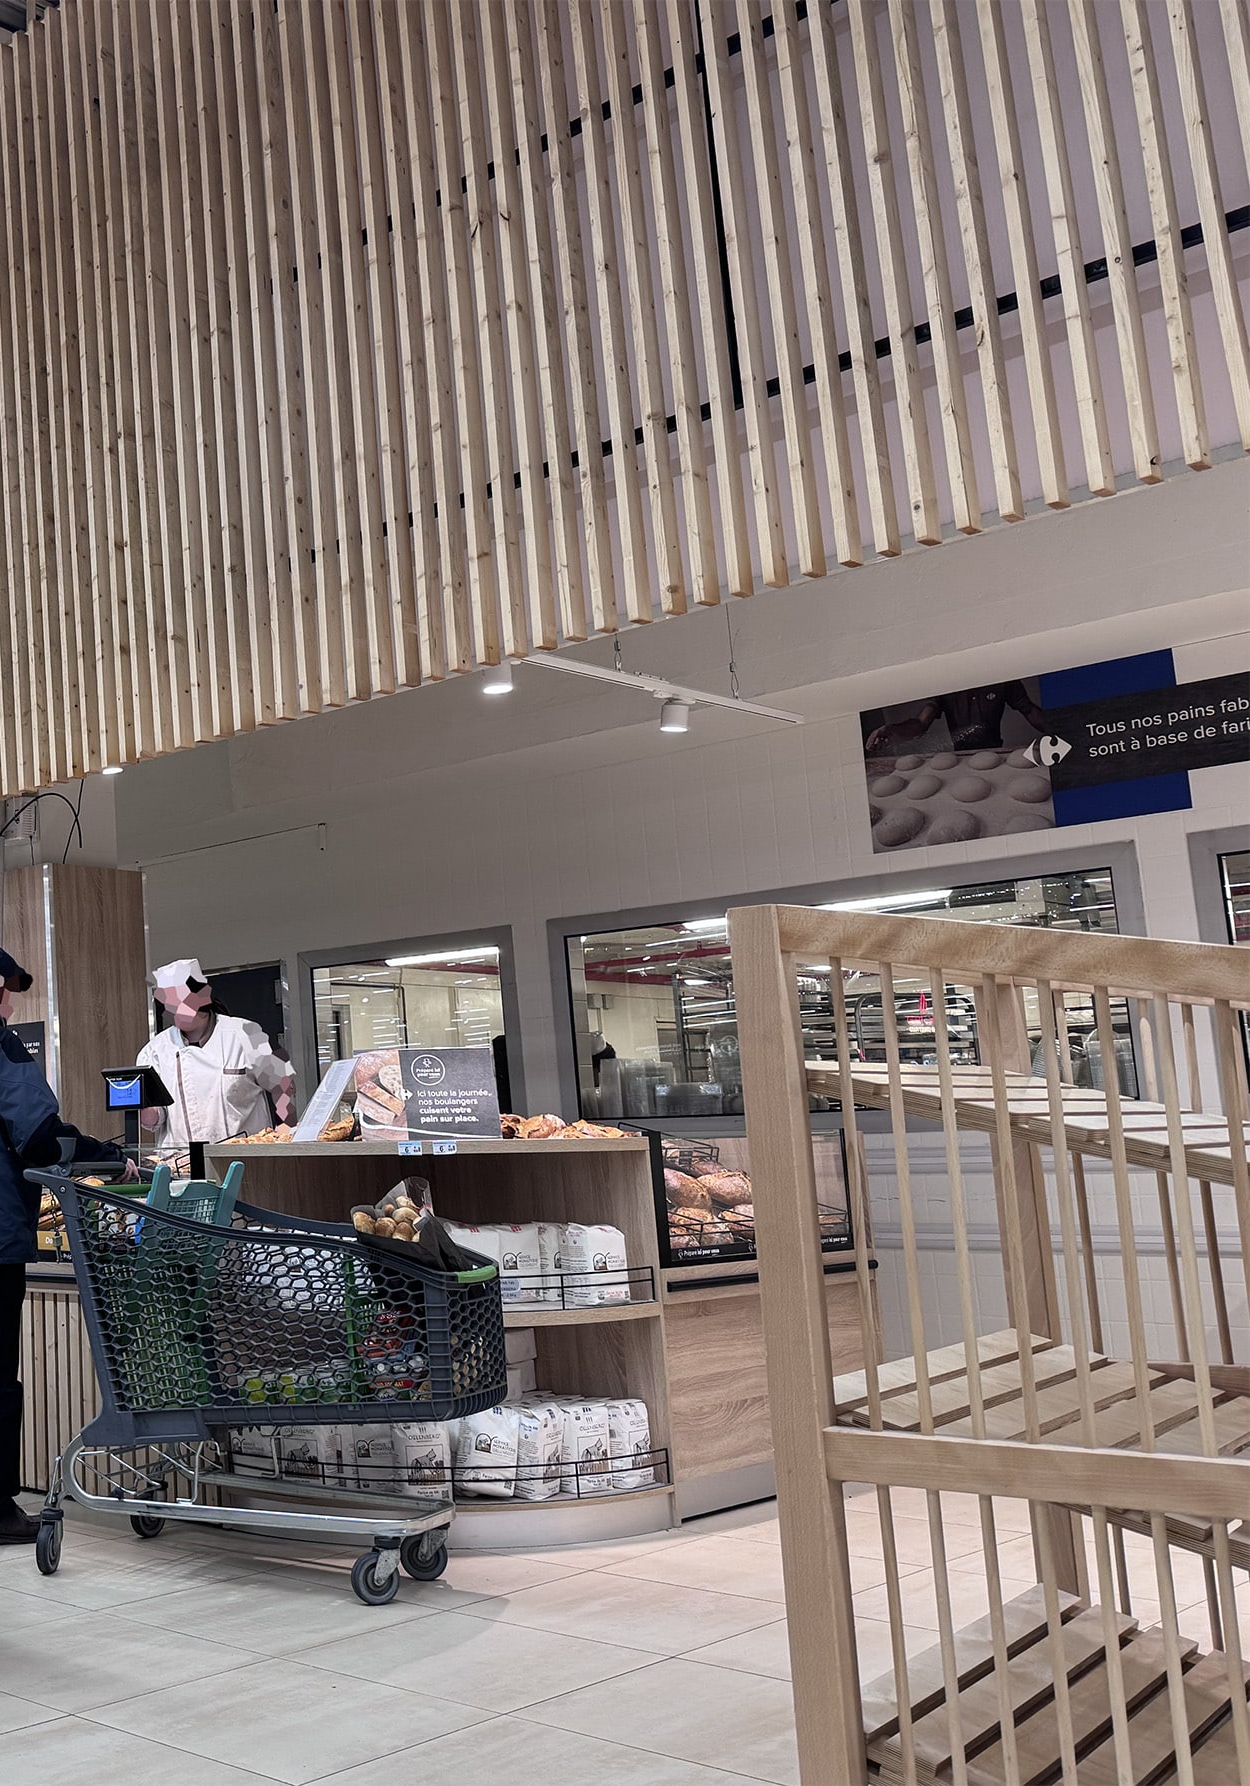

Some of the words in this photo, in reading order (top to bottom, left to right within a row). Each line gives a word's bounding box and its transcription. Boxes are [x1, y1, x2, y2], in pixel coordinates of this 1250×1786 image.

[1086, 721, 1126, 737] Tous
[1131, 714, 1162, 729] nos
[1167, 705, 1216, 726] pains
[1220, 697, 1250, 714] fab
[1089, 740, 1127, 758] sont
[1131, 736, 1141, 750] à
[1146, 731, 1188, 748] base
[1194, 725, 1216, 739] de
[1221, 717, 1250, 735] fari
[434, 1098, 478, 1107] boulangers
[420, 1114, 438, 1124] pain
[455, 1114, 480, 1123] place.
